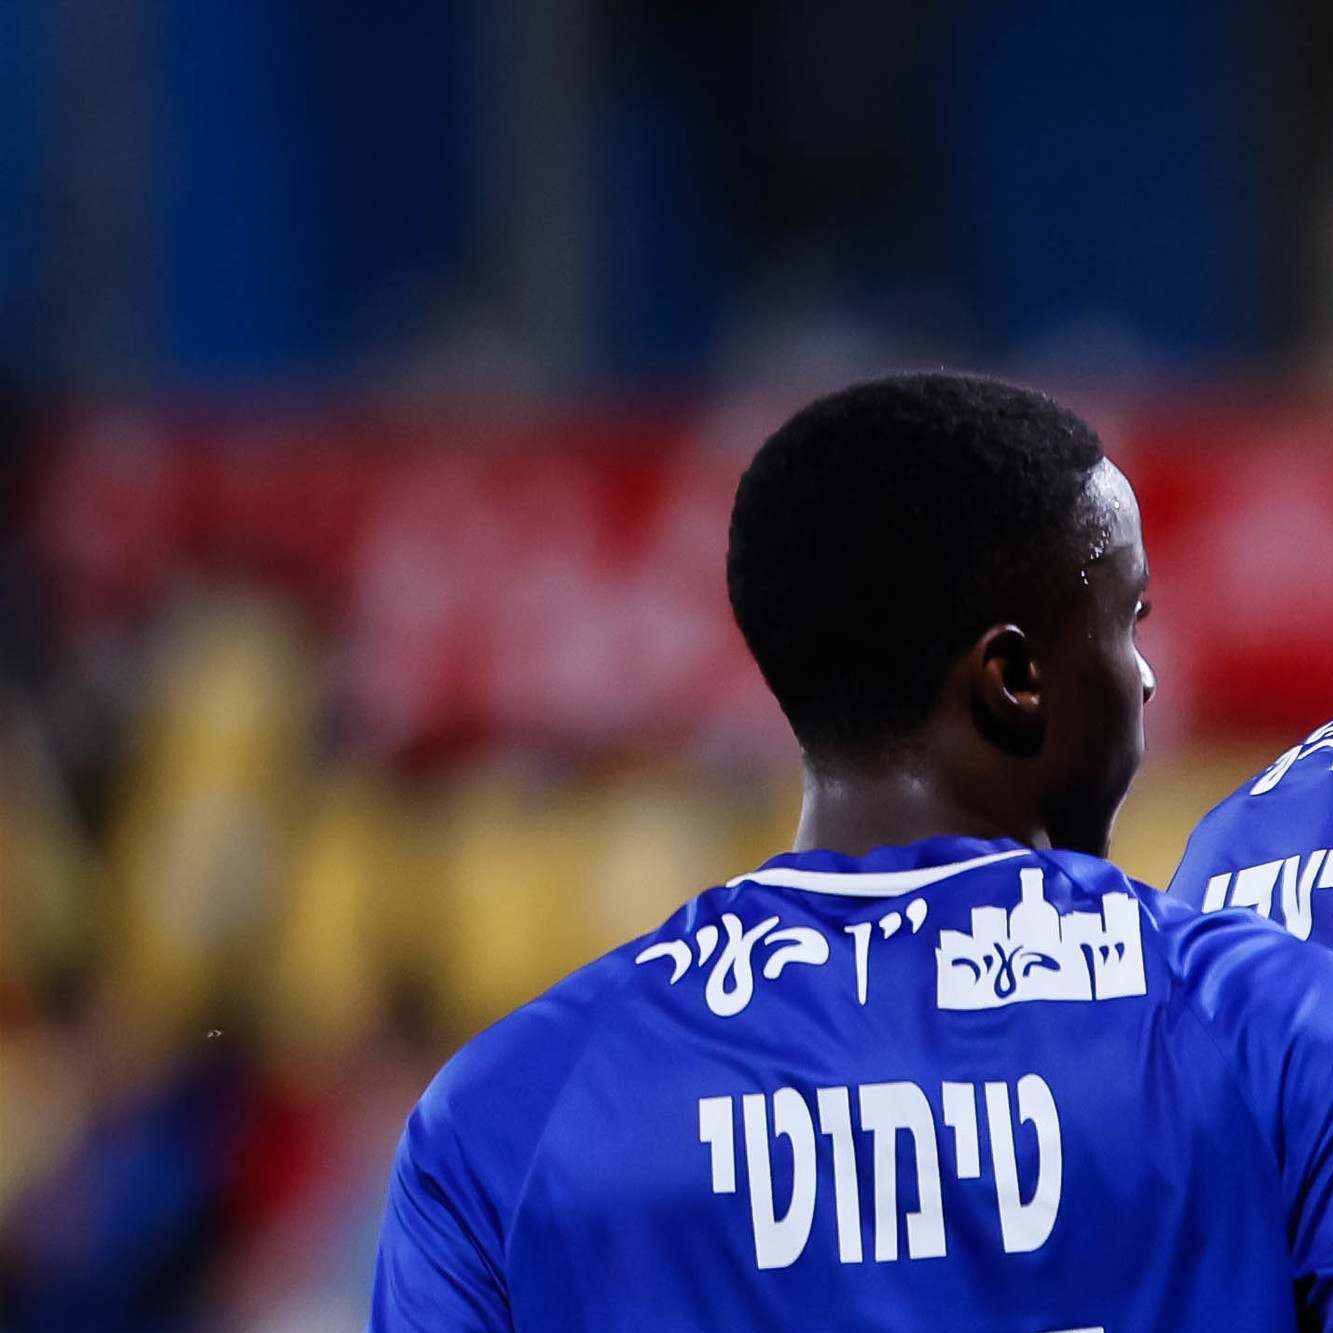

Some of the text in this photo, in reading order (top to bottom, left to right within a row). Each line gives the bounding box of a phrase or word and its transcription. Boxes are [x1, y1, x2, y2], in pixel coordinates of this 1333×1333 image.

[636, 898, 929, 1017] יין בעיר
[951, 942, 1125, 1001] יין בעיר
[699, 1074, 1063, 1270] טימוטי
